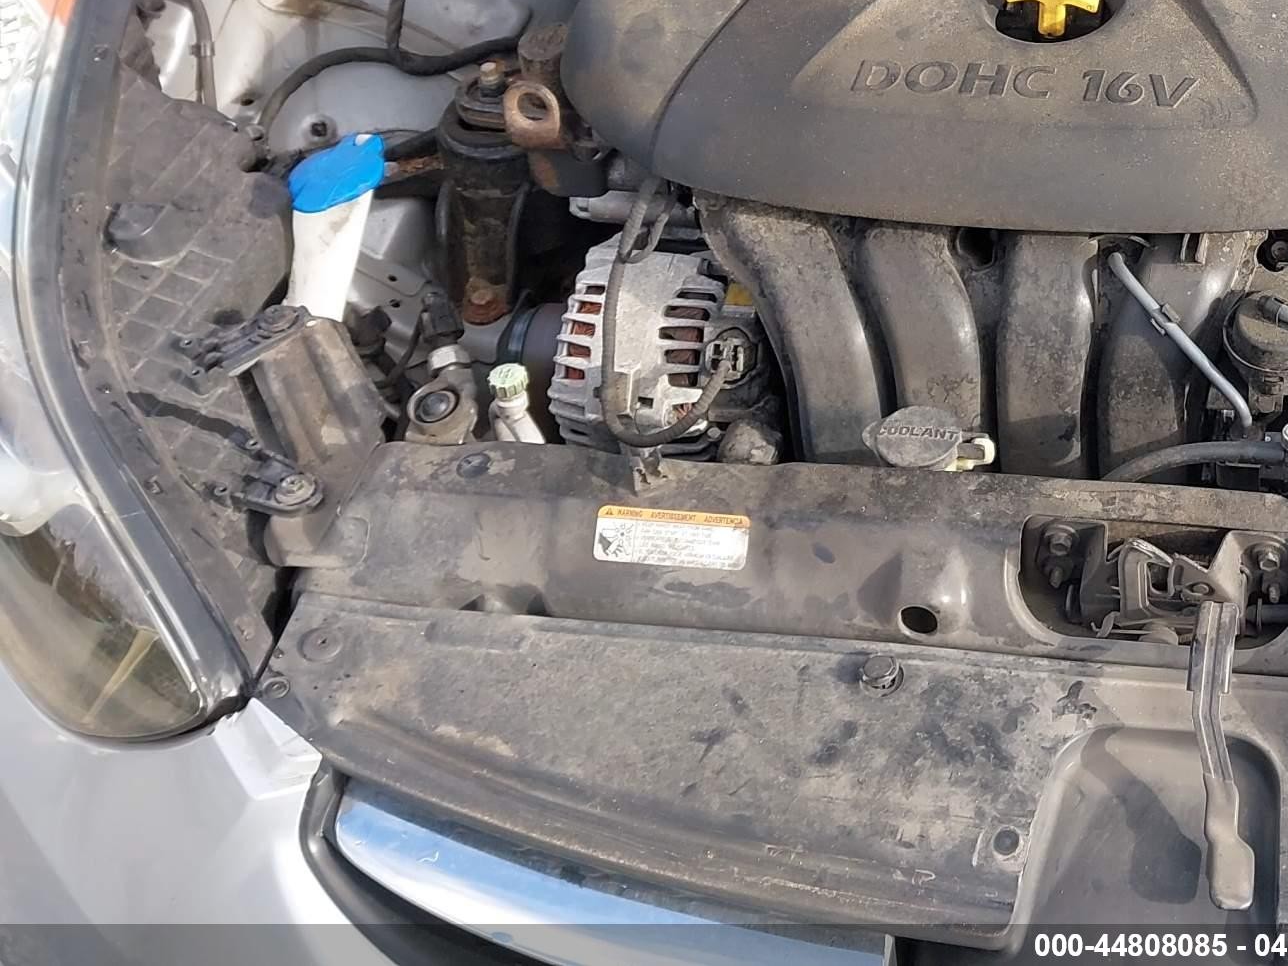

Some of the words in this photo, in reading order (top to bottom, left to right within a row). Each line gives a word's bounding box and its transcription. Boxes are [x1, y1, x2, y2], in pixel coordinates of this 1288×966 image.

[850, 59, 1057, 99] DOHC
[1081, 69, 1200, 108] 16V
[879, 425, 960, 441] COOLANT
[617, 509, 642, 517] WARNING
